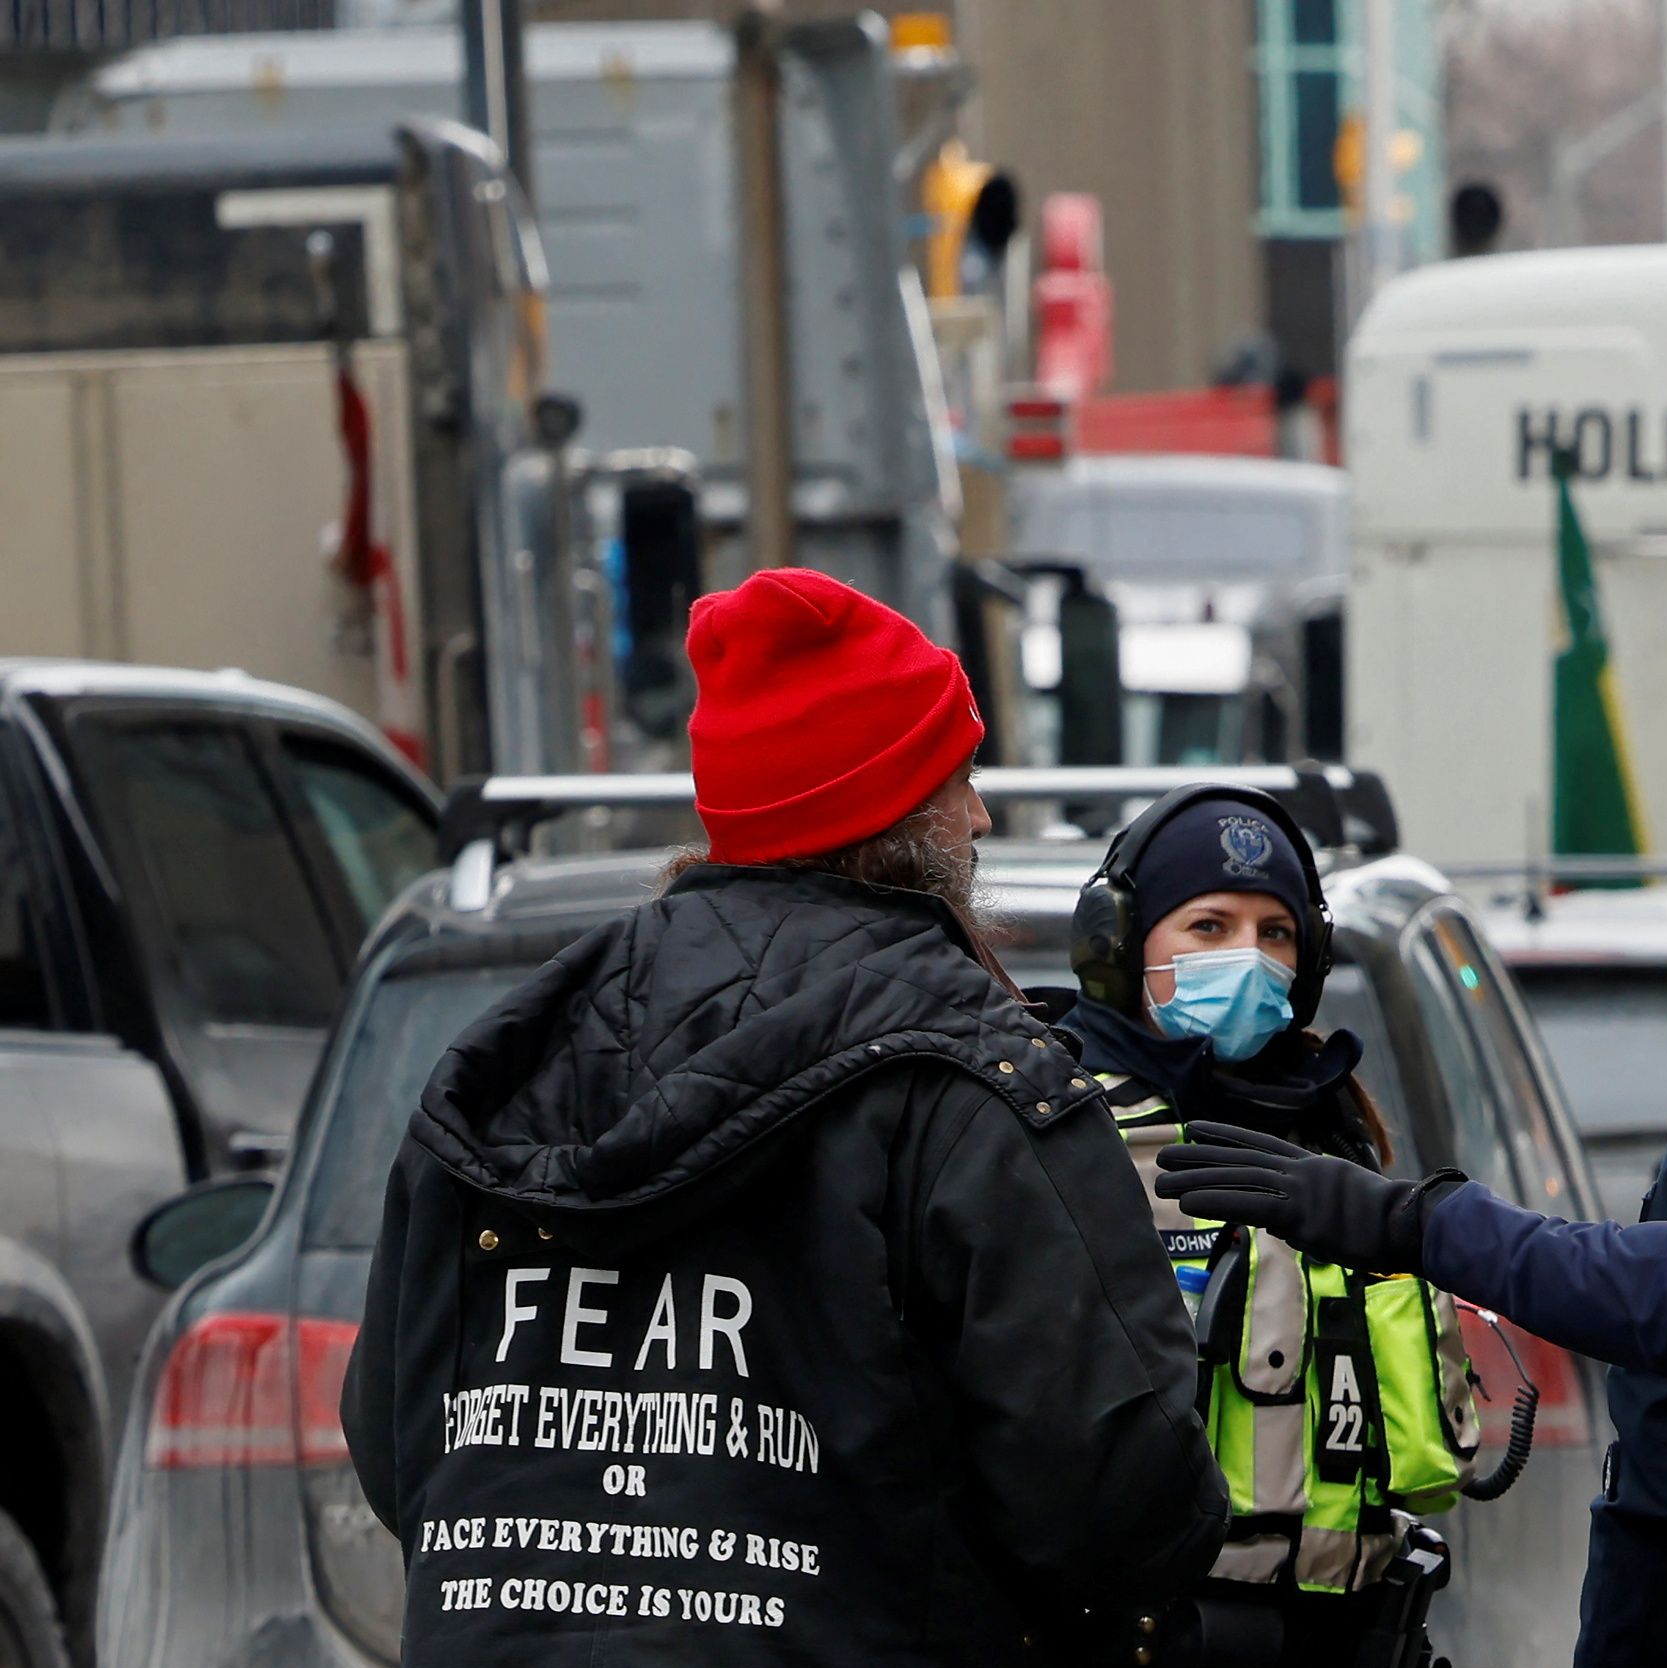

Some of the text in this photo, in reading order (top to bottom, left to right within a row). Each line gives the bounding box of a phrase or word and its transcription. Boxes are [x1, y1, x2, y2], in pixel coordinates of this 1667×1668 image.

[495, 1267, 752, 1377] FEAR
[1330, 1354, 1361, 1402] A
[443, 1383, 820, 1474] FORGET EVERYTHING & RUN
[1325, 1403, 1363, 1452] 22
[603, 1465, 646, 1497] OR
[420, 1517, 821, 1576] FACE EVERYTHING & RISE
[440, 1577, 786, 1627] THE CHOICE IS YOURS
